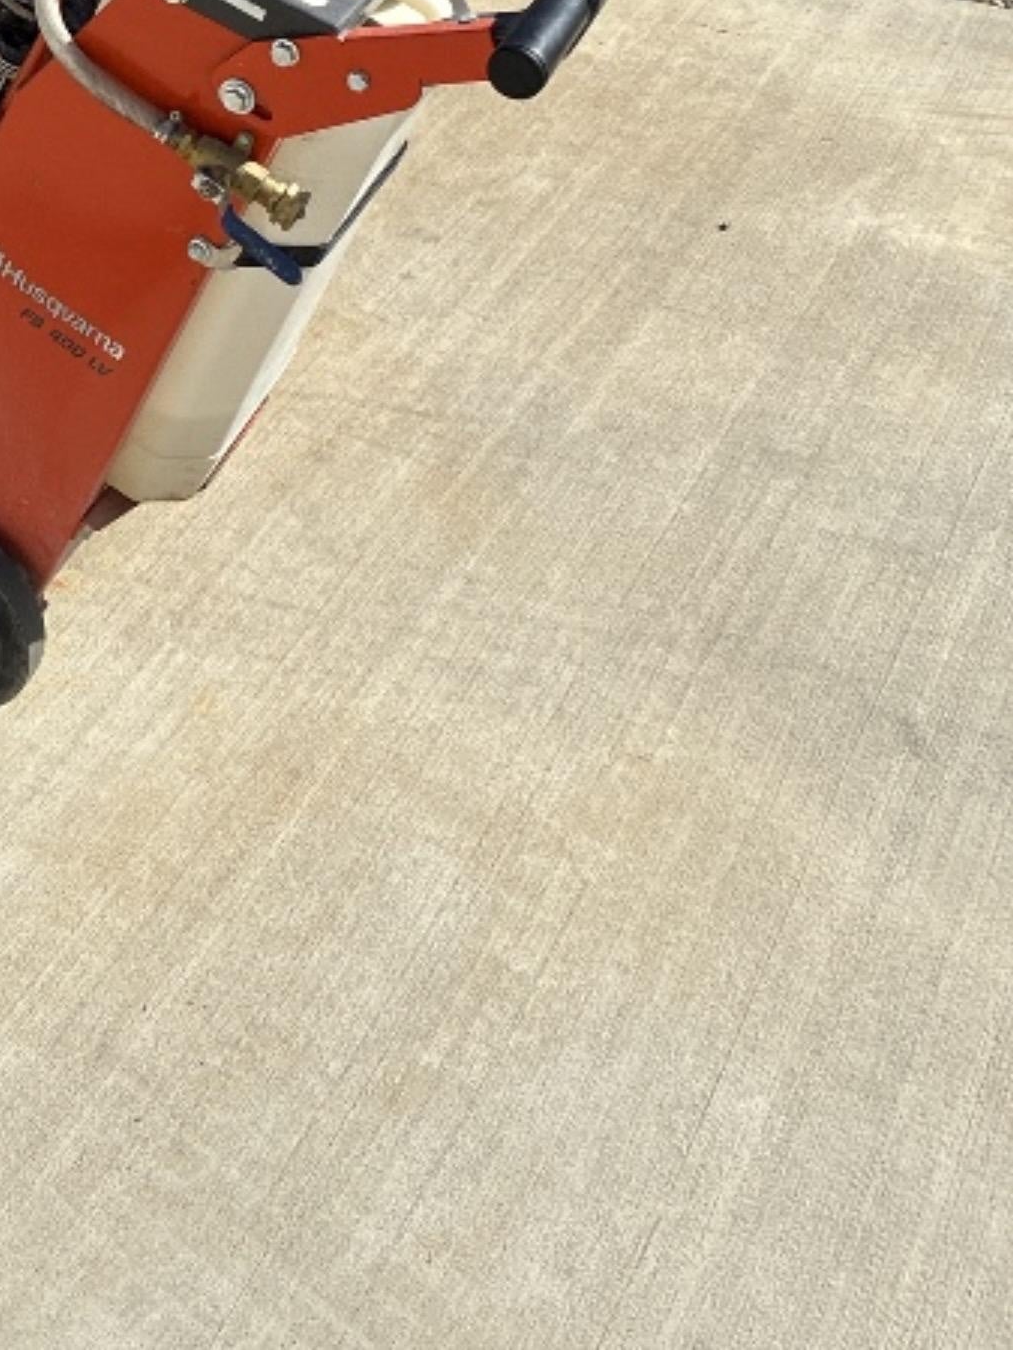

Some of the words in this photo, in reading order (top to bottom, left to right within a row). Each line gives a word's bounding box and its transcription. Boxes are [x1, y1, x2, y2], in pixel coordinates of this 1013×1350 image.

[1, 260, 126, 362] Husqvarna
[48, 329, 87, 359] 400
[88, 356, 115, 377] LV
